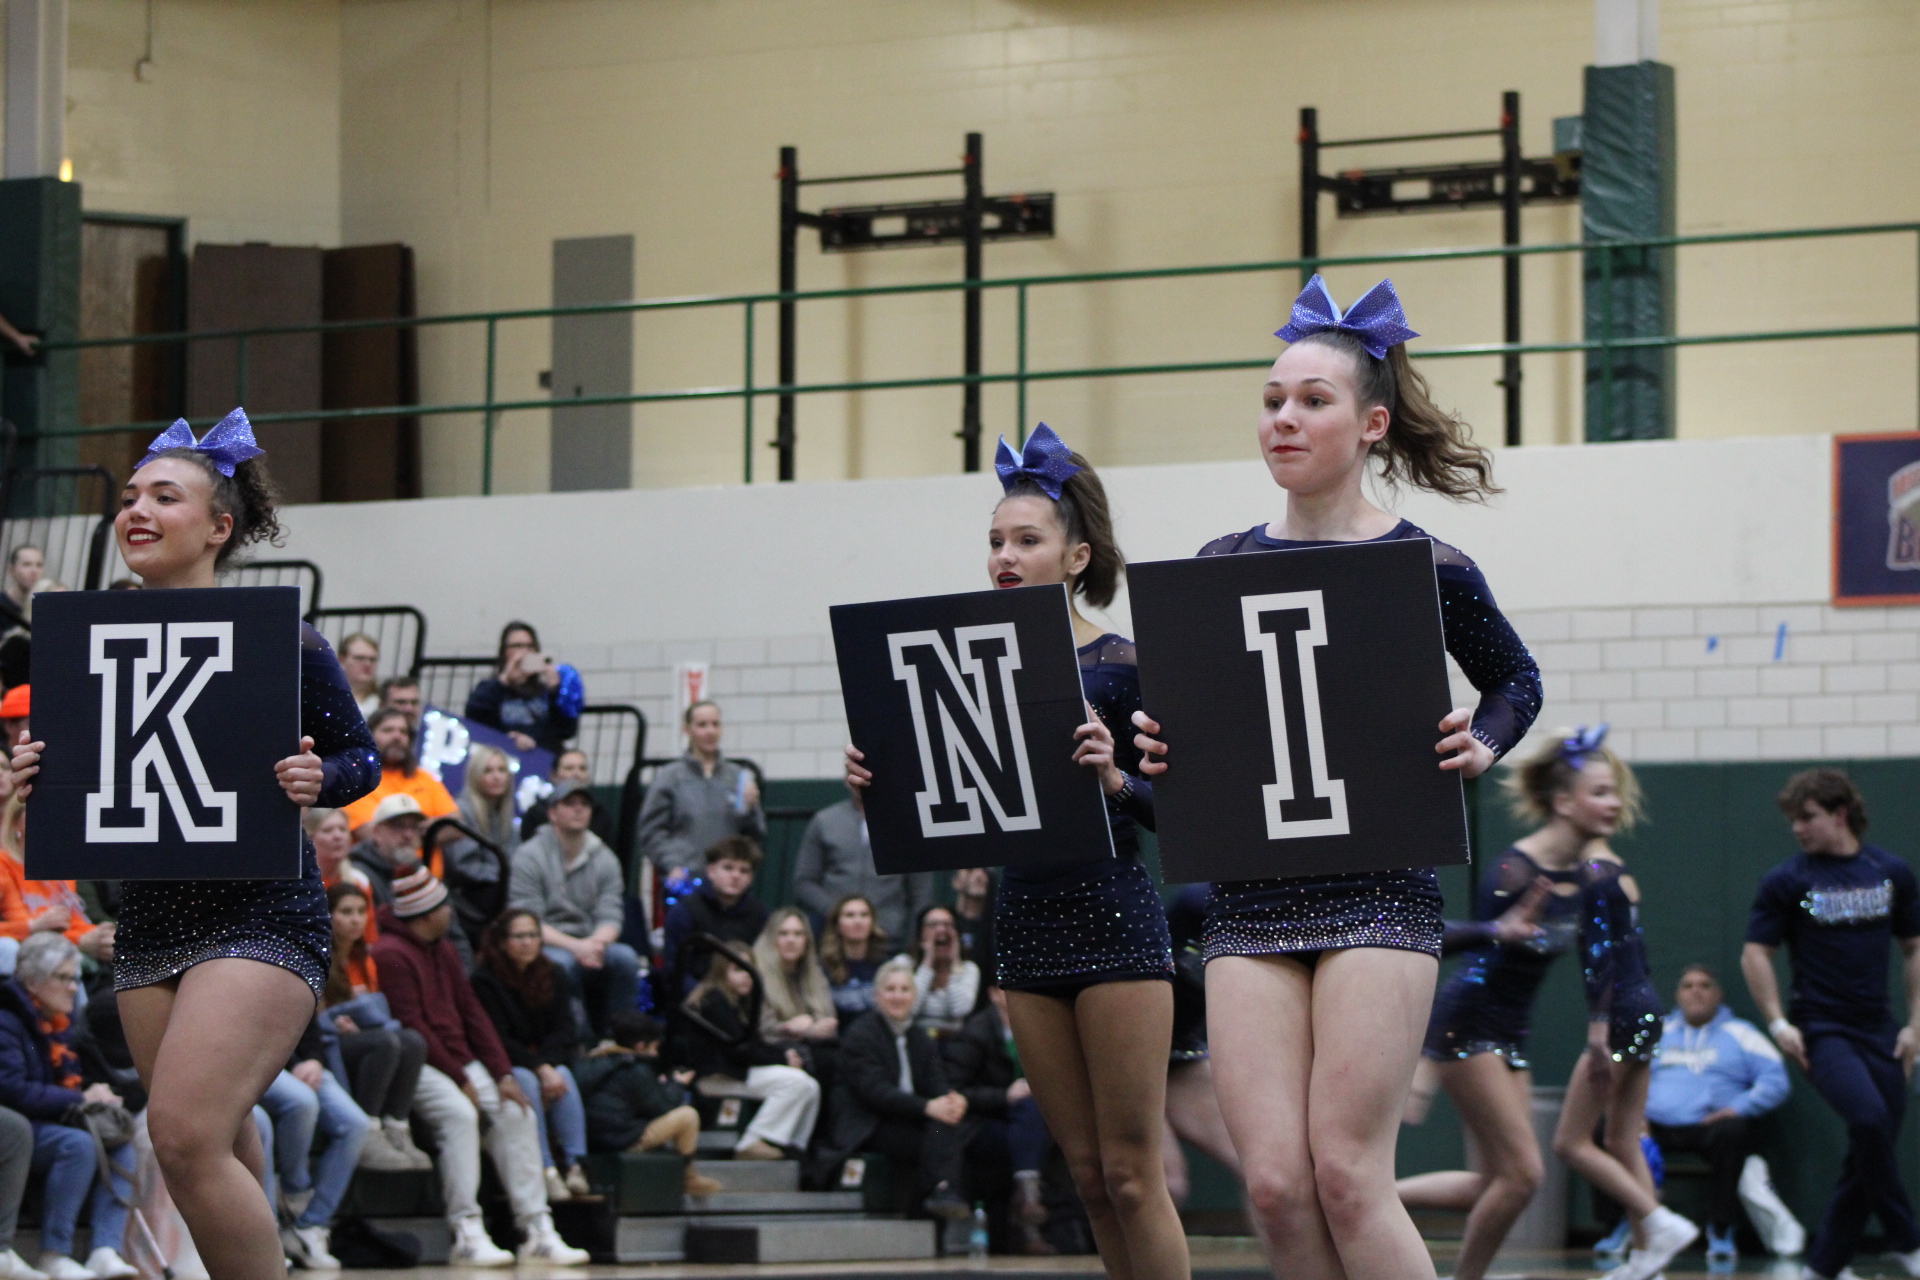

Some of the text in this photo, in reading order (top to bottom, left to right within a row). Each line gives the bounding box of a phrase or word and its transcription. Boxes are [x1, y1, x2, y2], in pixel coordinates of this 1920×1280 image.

[86, 622, 237, 842] K
[887, 623, 1041, 837] N
[1241, 590, 1350, 839] I
